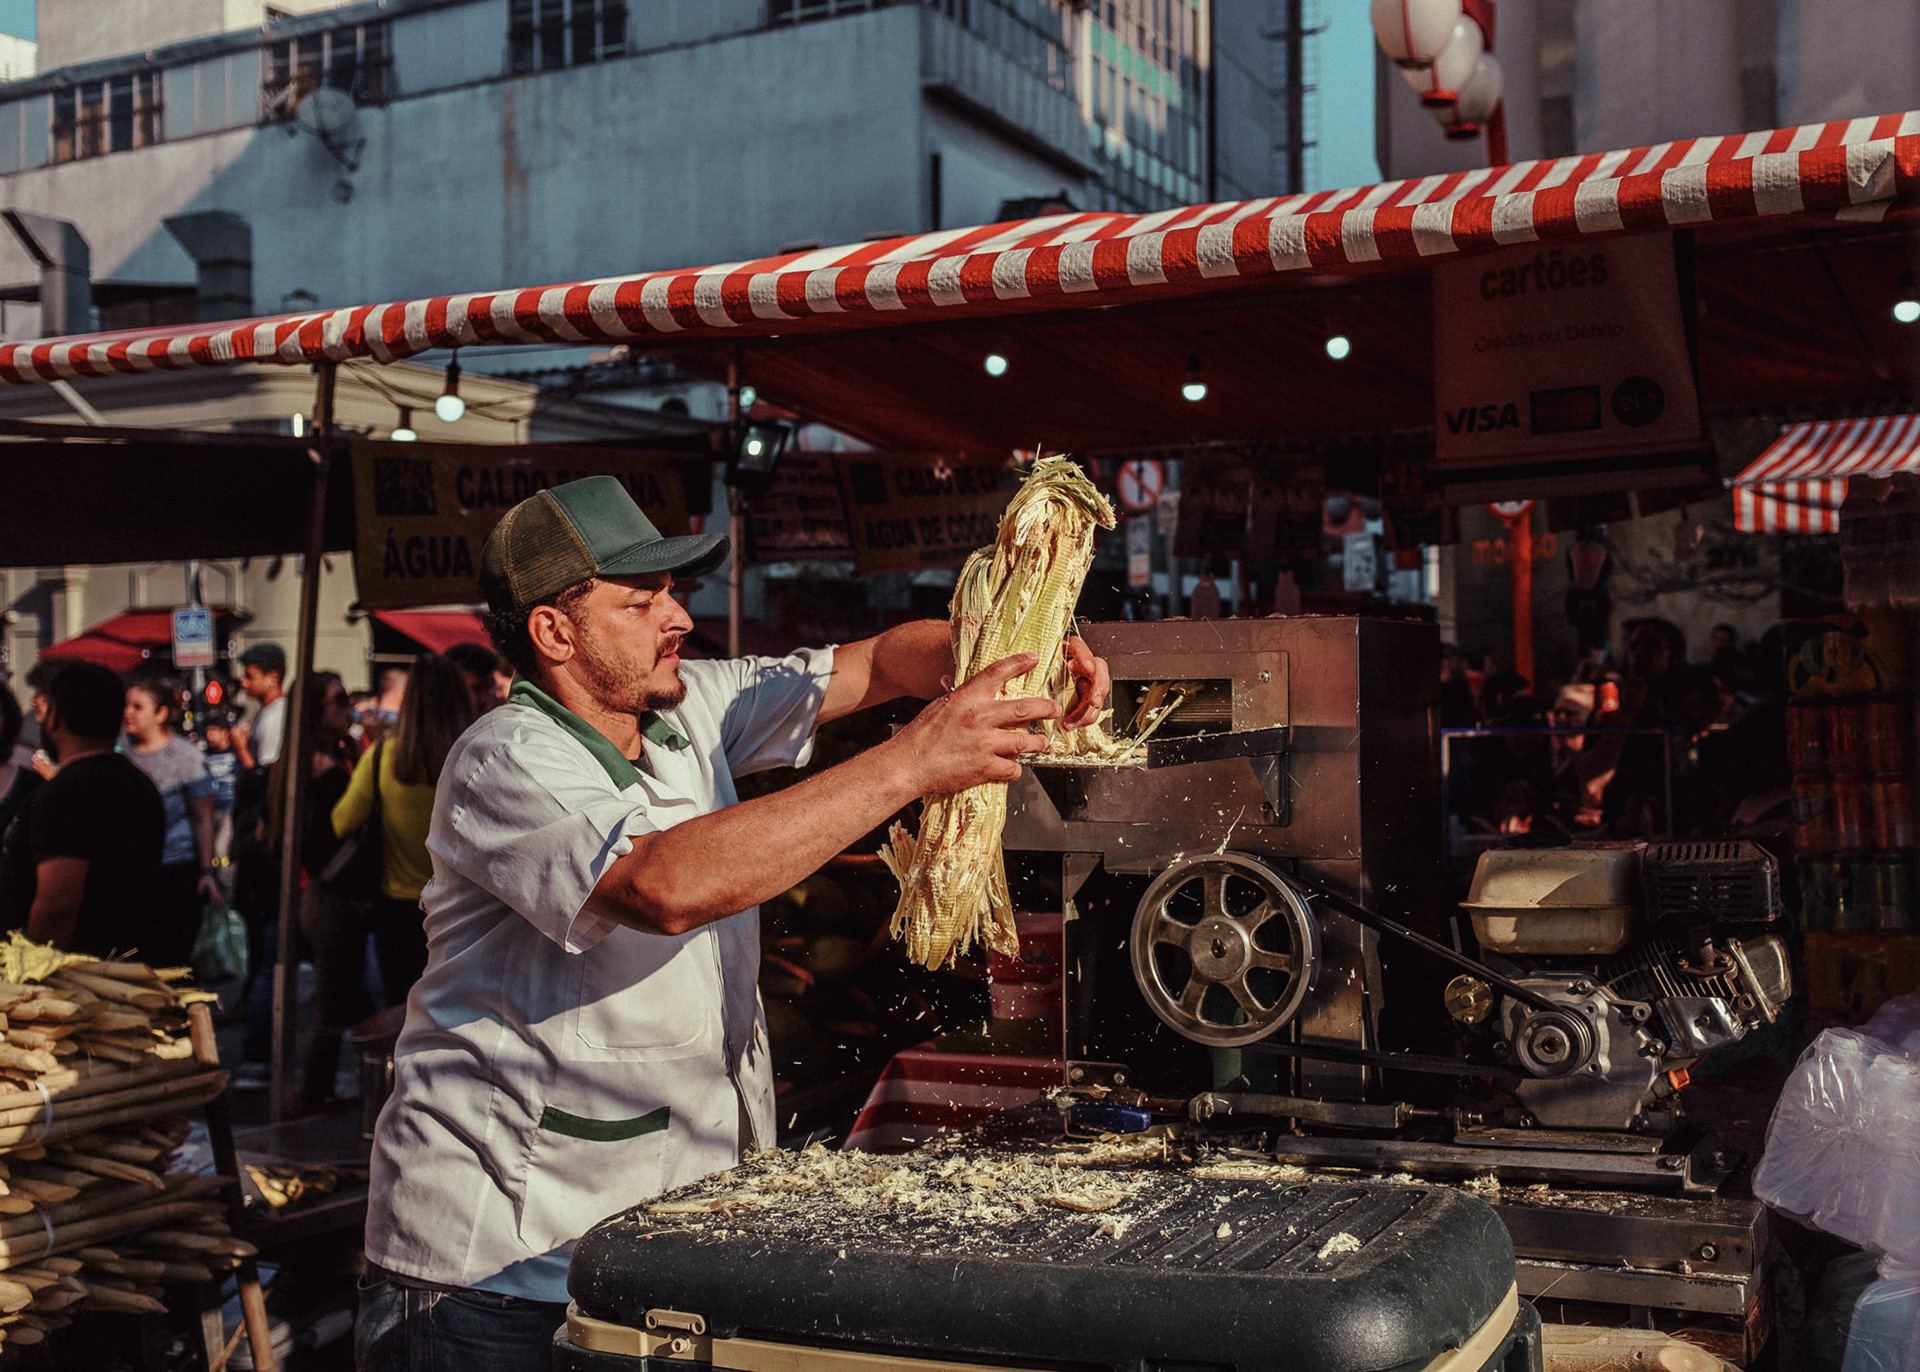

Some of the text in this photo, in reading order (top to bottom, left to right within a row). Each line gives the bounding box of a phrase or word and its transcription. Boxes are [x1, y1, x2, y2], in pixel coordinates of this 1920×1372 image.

[1480, 247, 1608, 301] cartões
[1474, 321, 1624, 353] Crédito ou Débito
[1445, 403, 1522, 436] VISA
[384, 527, 473, 580] ÁGUA
